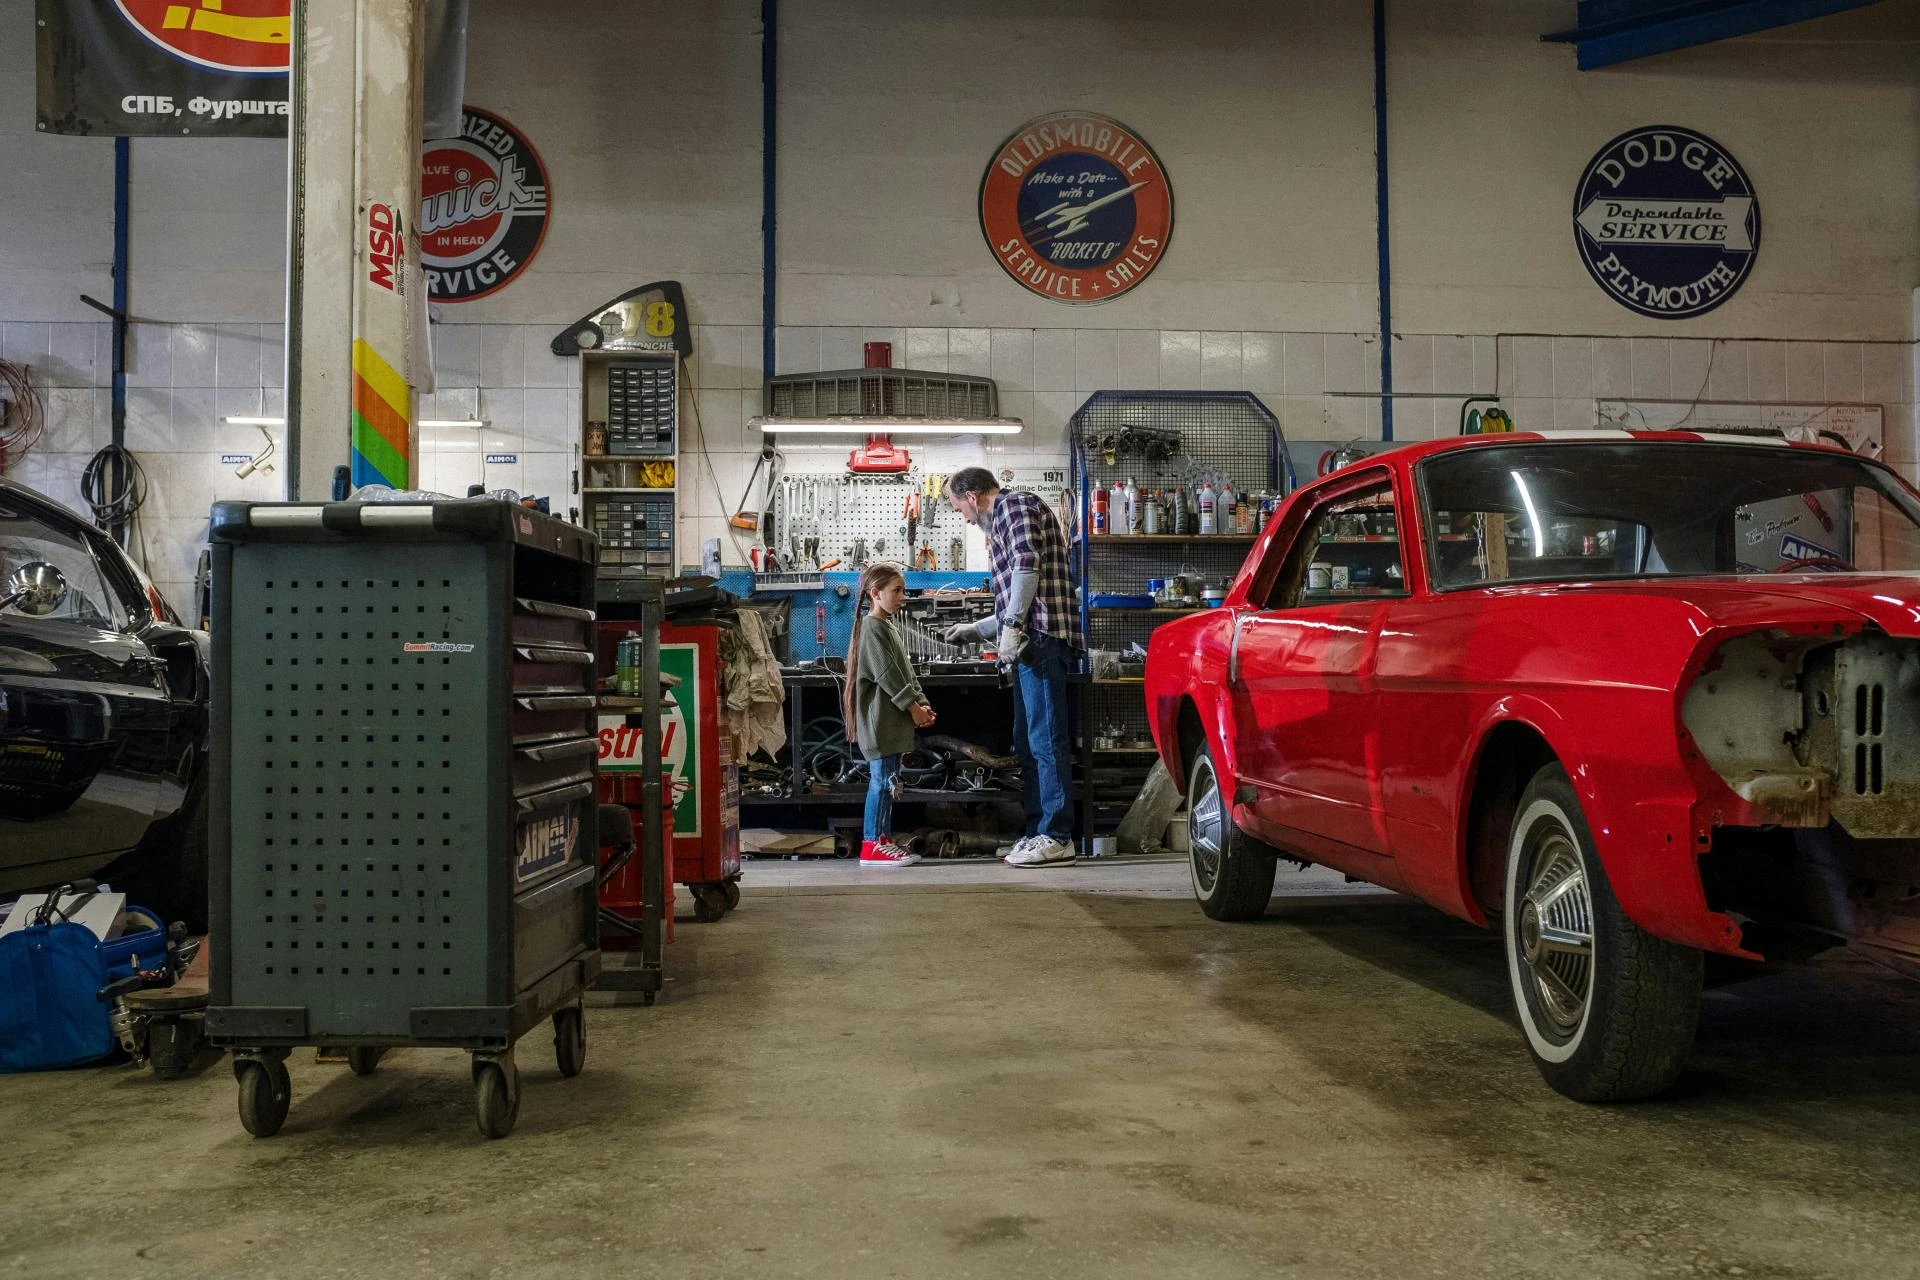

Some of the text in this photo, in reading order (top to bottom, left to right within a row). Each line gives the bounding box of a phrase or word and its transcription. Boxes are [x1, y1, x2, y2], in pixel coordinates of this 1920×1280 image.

[121, 95, 289, 119] СПБ, Фуршта
[460, 114, 514, 156] RIZED
[1000, 122, 1150, 178] OLDSMOBILE
[422, 165, 450, 175] ALVE
[1596, 135, 1735, 190] DODGE
[1028, 172, 1064, 185] Make
[1066, 175, 1075, 184] a
[421, 153, 534, 235] uick
[1058, 186, 1095, 198] with a
[1605, 203, 1725, 221] Dependable
[437, 236, 485, 246] IN HEAD
[1599, 222, 1728, 241] SERVICE
[369, 203, 394, 291] MSD
[1050, 242, 1103, 259] "ROCKET
[425, 248, 517, 293] RVICE
[1000, 239, 1081, 297] SERVICE
[1105, 235, 1158, 289] SALES
[1597, 252, 1736, 309] PLYMOUTH
[623, 301, 675, 337] 78
[1037, 484, 1063, 492] Deville
[1043, 471, 1064, 482] 1971
[1782, 542, 1838, 565] AIM
[597, 722, 677, 759] strl
